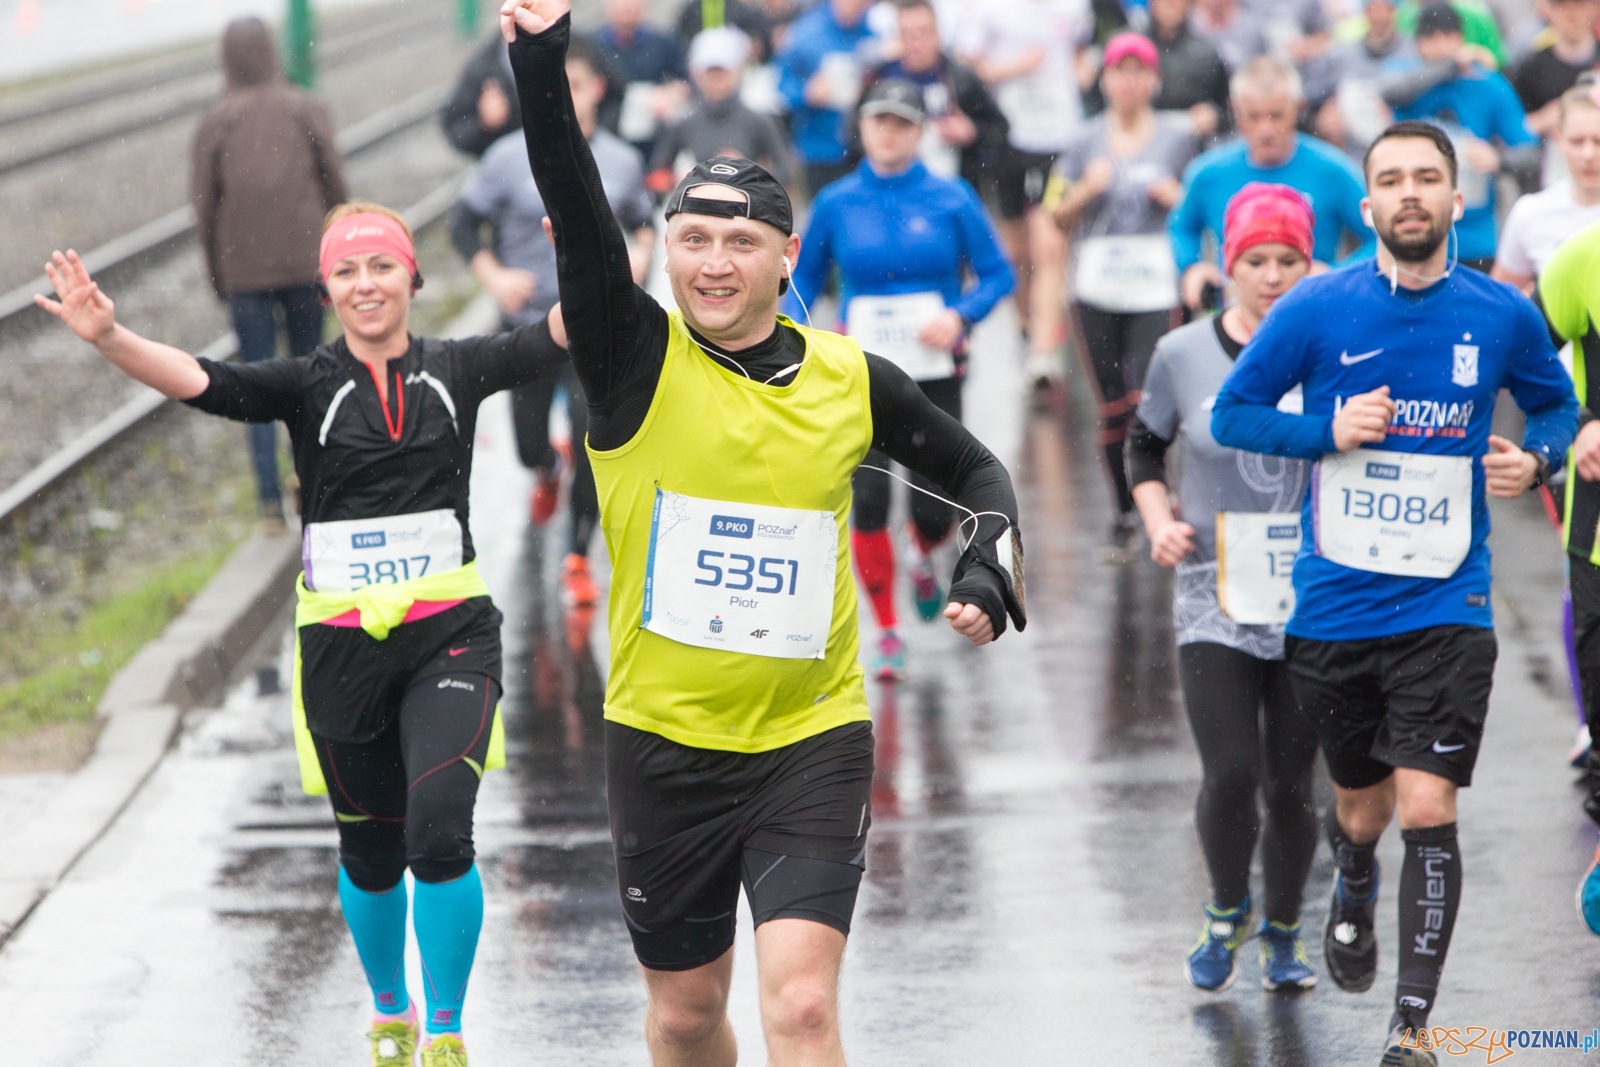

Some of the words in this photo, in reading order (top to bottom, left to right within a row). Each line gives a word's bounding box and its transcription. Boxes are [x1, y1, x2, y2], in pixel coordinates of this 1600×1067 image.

[1383, 425, 1422, 437] OCNI
[1341, 487, 1450, 526] 13084
[349, 555, 431, 591] 3817
[694, 549, 799, 596] 5351
[729, 596, 759, 609] Piotr
[749, 628, 770, 639] 4F
[450, 680, 475, 692] asics
[1414, 846, 1452, 956] Kalenji
